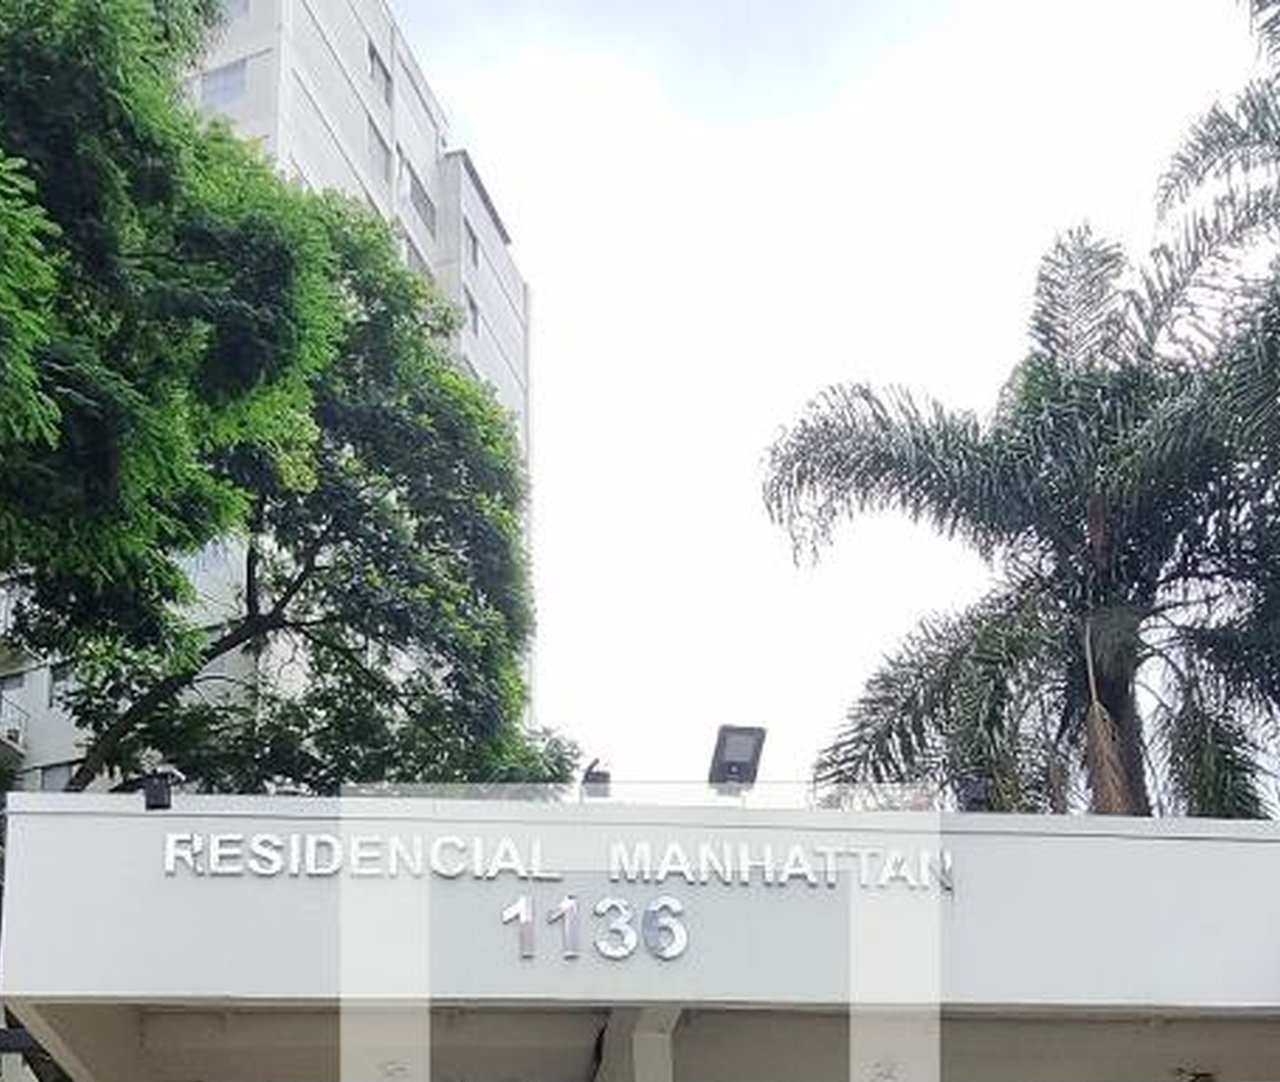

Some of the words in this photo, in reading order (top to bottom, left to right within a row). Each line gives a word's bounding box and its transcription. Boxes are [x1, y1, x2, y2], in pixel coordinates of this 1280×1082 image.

[164, 832, 563, 883] RESIDENCIAL
[609, 840, 954, 893] MANHATTAN
[502, 896, 688, 961] 1136
